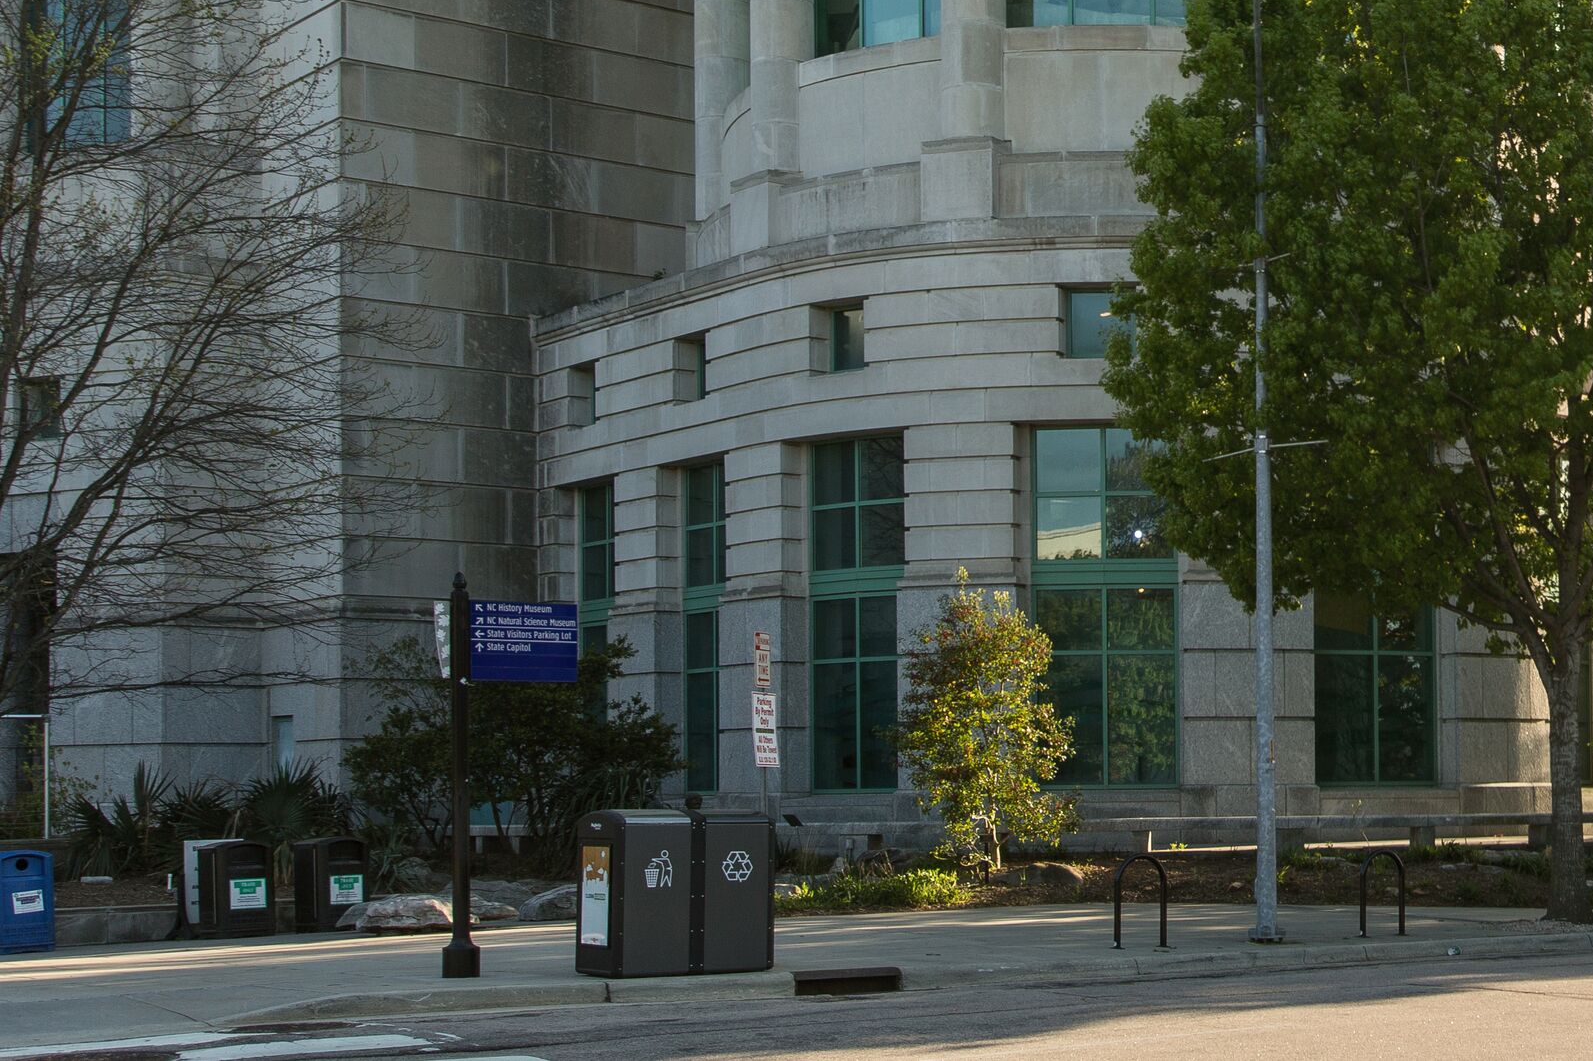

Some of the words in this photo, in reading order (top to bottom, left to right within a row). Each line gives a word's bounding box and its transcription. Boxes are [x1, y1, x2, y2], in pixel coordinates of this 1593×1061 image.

[487, 603, 496, 612] NC
[498, 603, 522, 614] History
[524, 605, 552, 613] Museum
[487, 617, 496, 625] NC
[498, 617, 522, 625] Natural
[524, 618, 548, 626] Science
[550, 618, 576, 627] Museum
[487, 629, 504, 638] State
[507, 629, 531, 639] Visitors
[534, 630, 559, 641] Parking
[561, 631, 572, 640] Lot
[487, 642, 504, 651] State
[507, 643, 531, 653] Capitol
[758, 653, 768, 664] ANY
[756, 696, 772, 709] Parking
[761, 707, 774, 717] Permit
